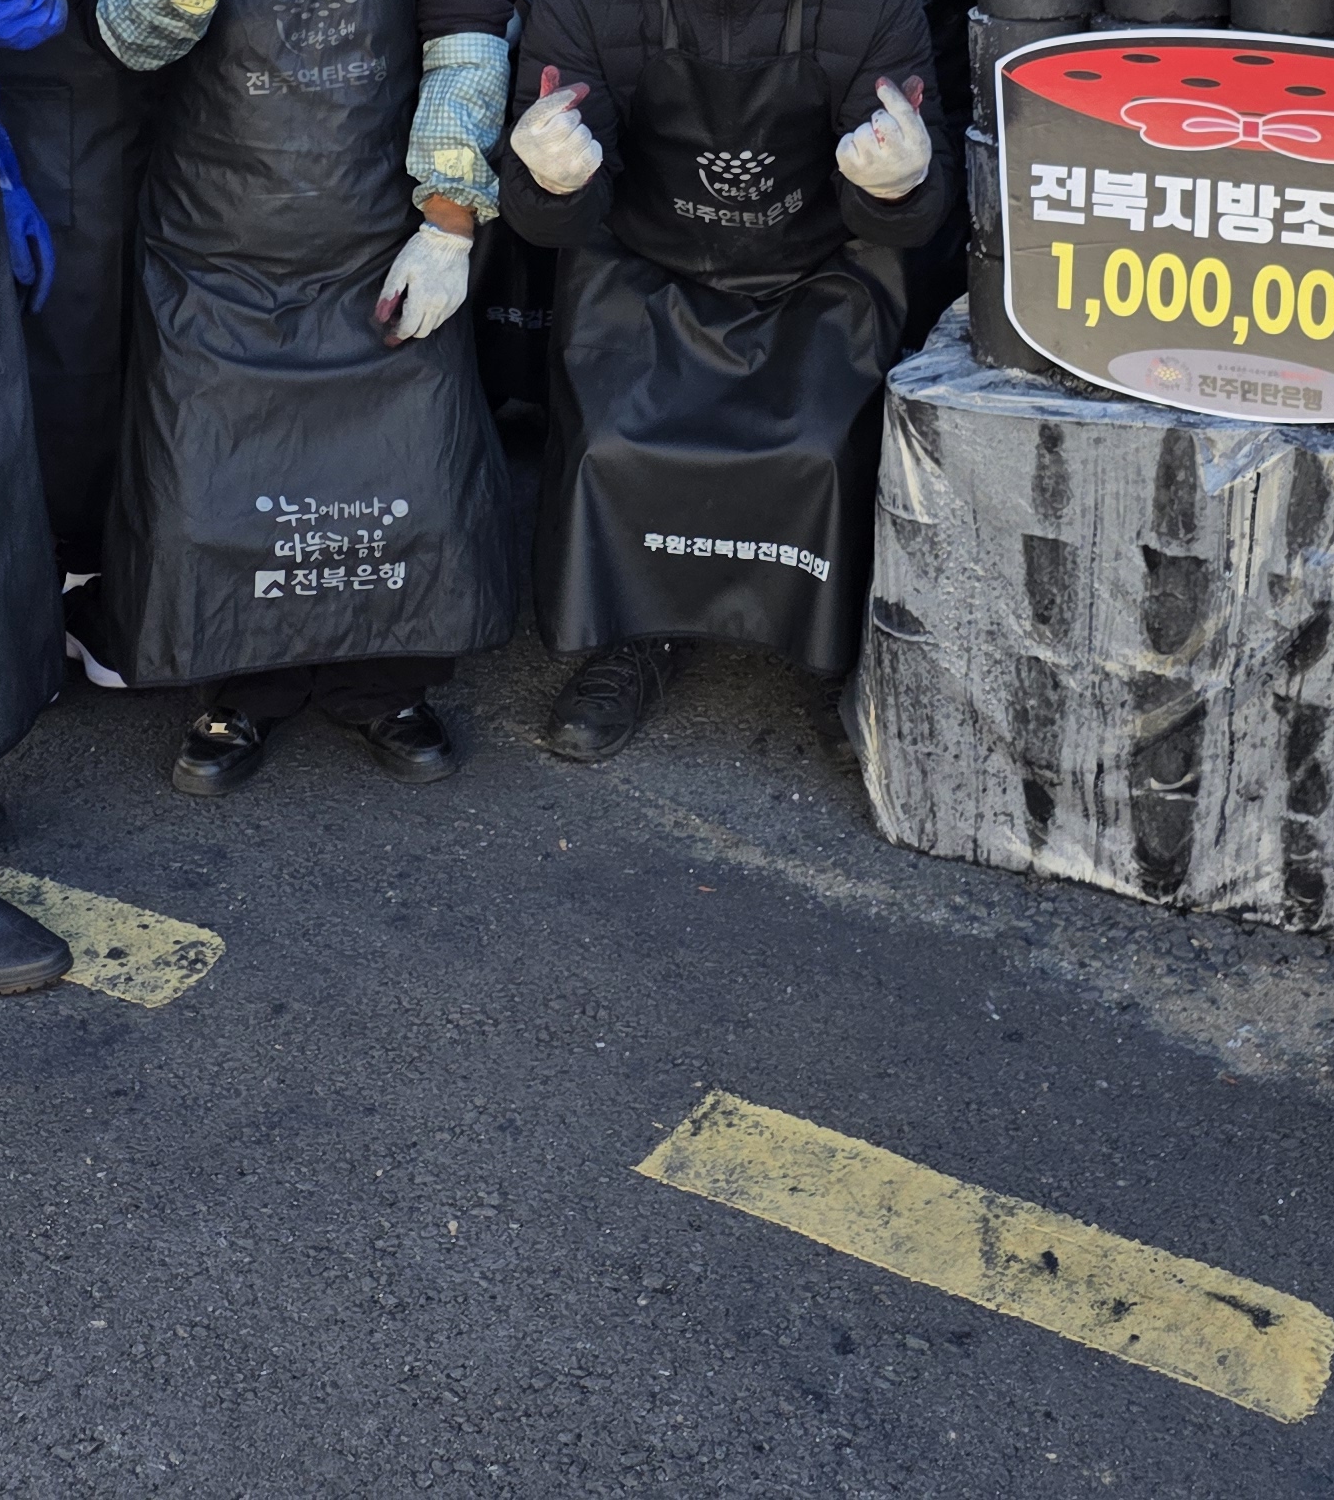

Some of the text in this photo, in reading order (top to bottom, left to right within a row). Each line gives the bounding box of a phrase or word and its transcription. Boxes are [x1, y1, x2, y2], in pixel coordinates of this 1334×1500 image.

[291, 19, 356, 50] 연탄은행
[246, 56, 387, 95] 전주연탄은행
[713, 177, 775, 201] 연탄은행
[673, 188, 803, 228] 전주연탄은행
[1198, 374, 1323, 411] 전주연탄은행
[276, 495, 387, 526] 누구에게나
[275, 529, 387, 563] 따뜻한 금융
[644, 533, 830, 582] 후원:전북발전협의회
[291, 561, 406, 595] 전북은행
